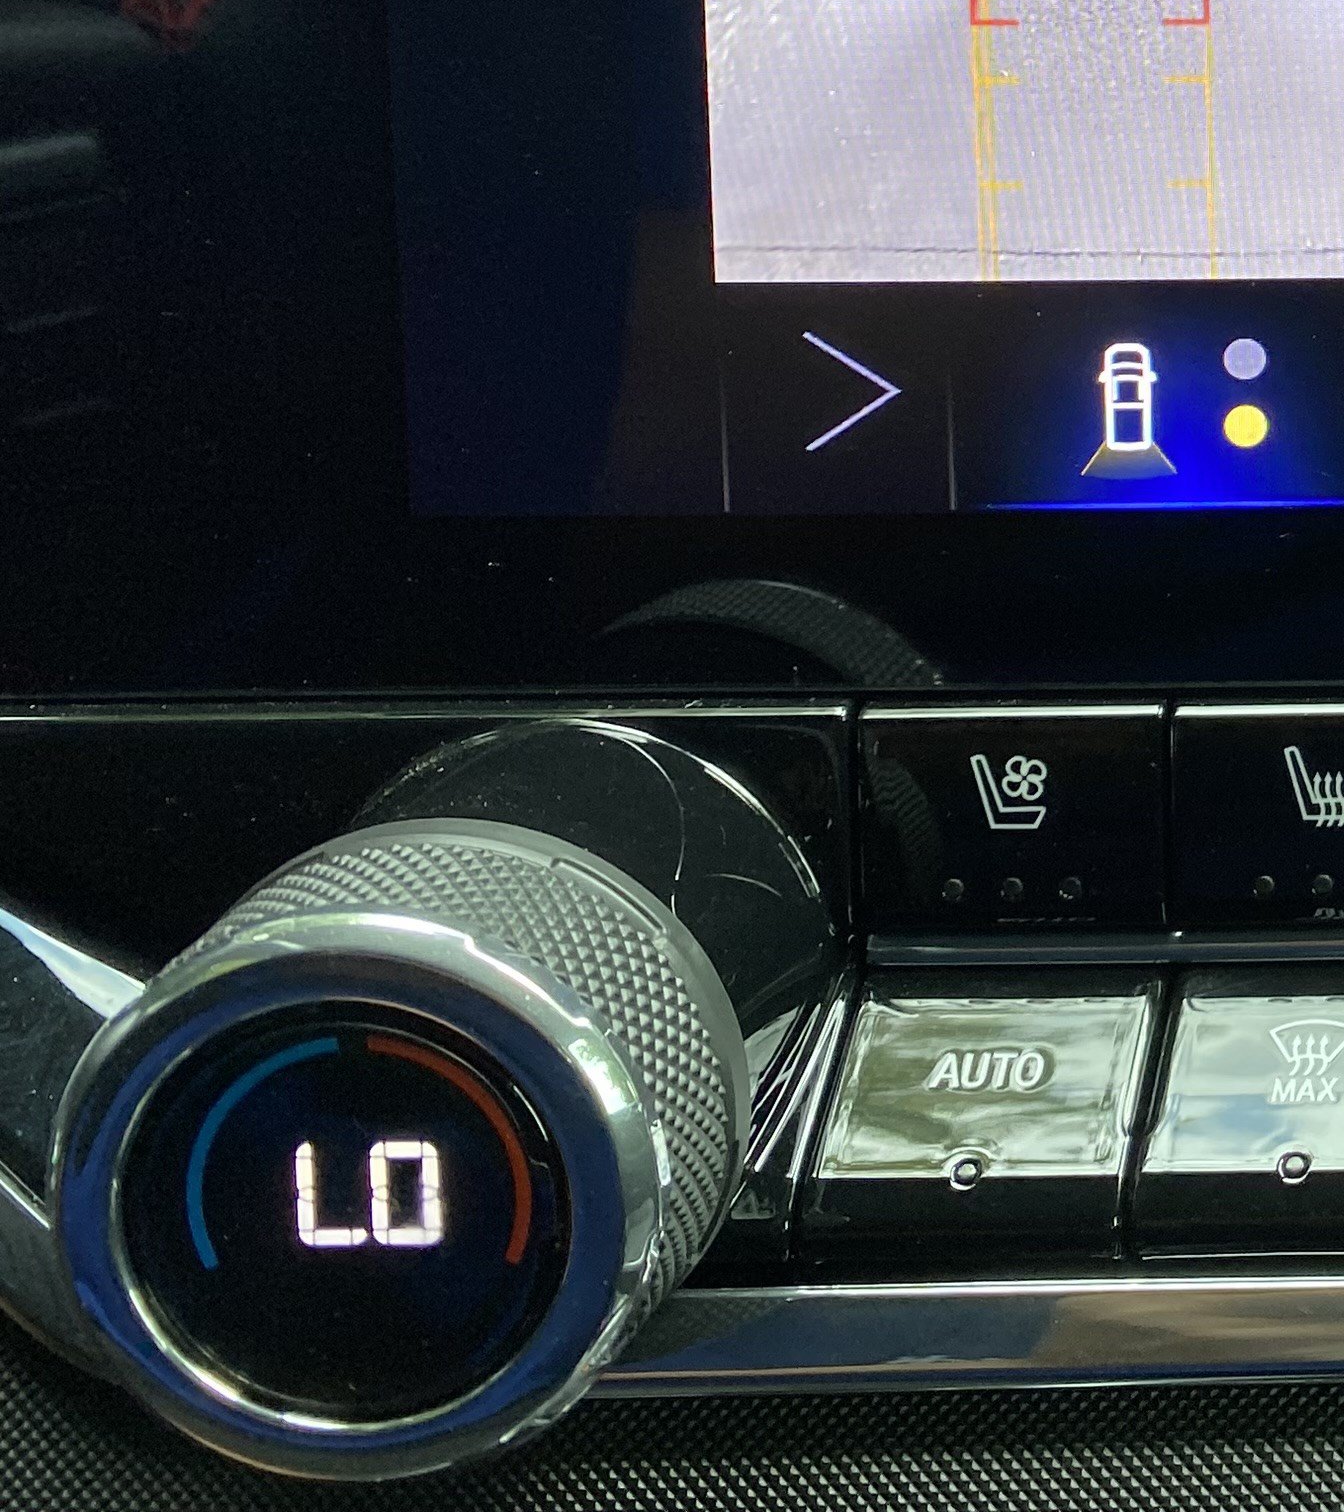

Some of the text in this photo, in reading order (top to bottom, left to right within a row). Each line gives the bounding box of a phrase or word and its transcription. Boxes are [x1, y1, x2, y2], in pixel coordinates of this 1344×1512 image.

[929, 1050, 1046, 1091] AUTO
[1270, 1076, 1339, 1103] MAX
[295, 1140, 445, 1247] LO
